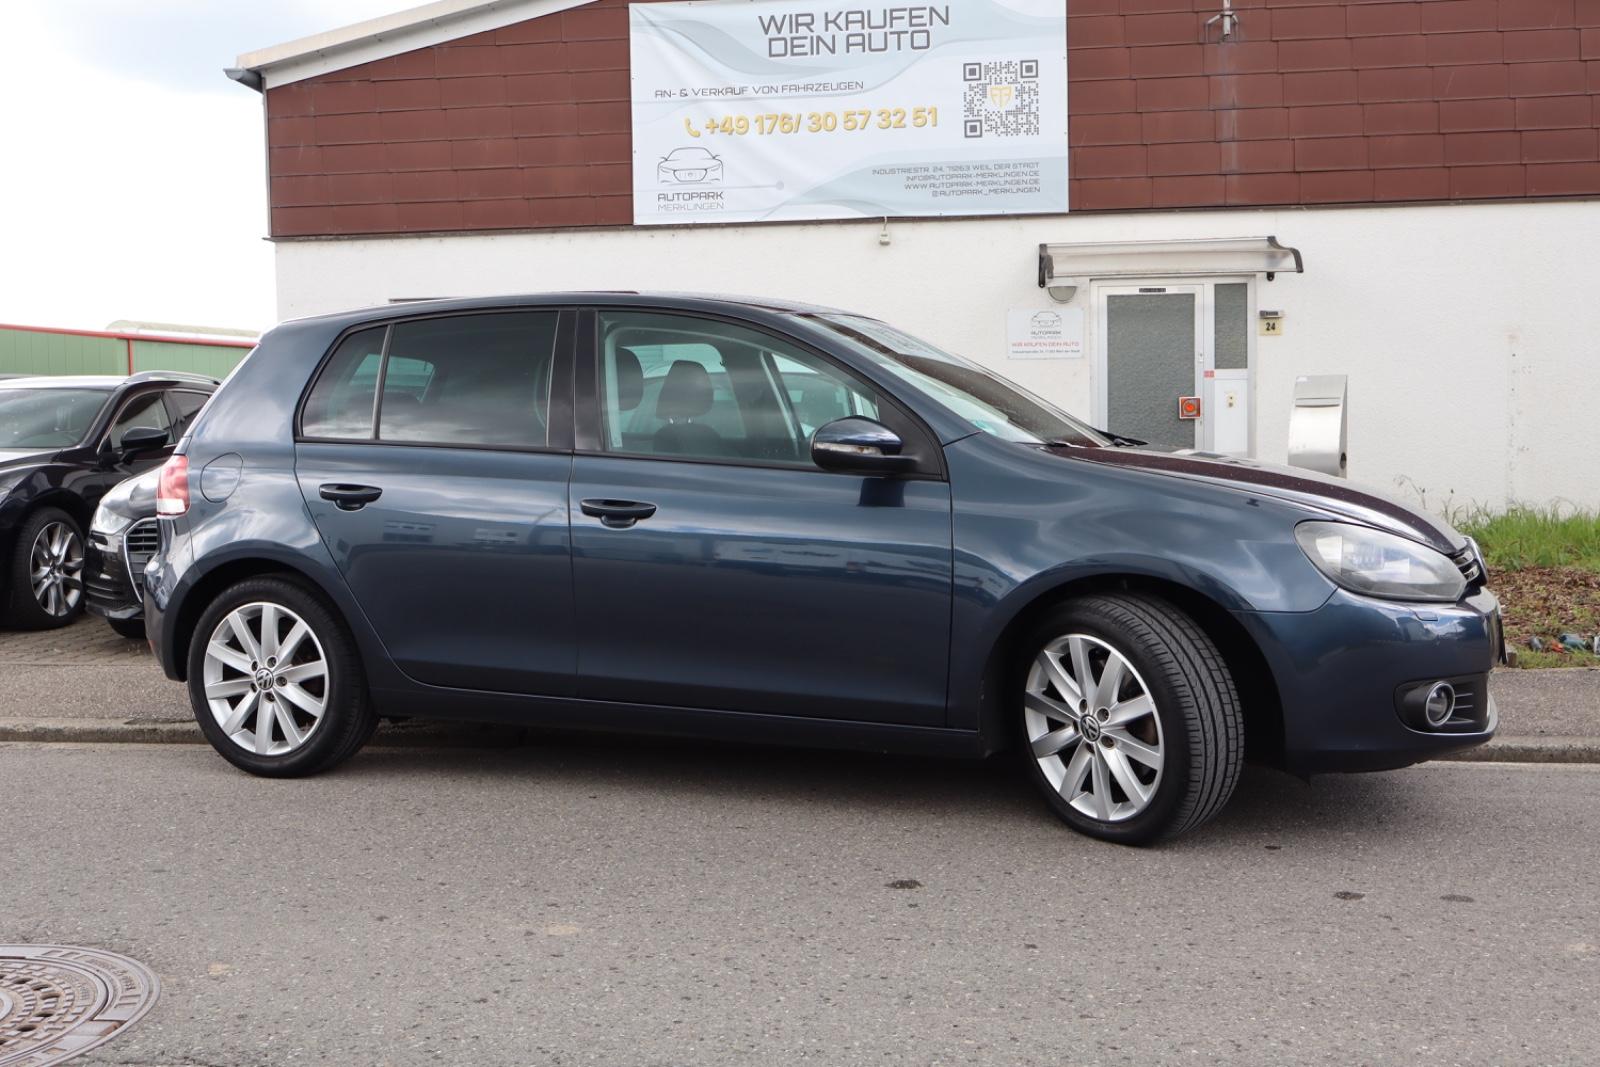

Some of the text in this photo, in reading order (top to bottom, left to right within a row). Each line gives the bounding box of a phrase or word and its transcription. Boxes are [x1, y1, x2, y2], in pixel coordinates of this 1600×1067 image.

[758, 5, 950, 35] WIR KAUFEN
[768, 29, 931, 58] DEIN AUTO
[680, 88, 689, 97] &
[692, 86, 749, 97] VERKAUF
[752, 85, 780, 95] VON
[781, 81, 864, 94] FAHRZEUGEN
[705, 105, 938, 136] +49 176/ 30 57 32 51
[657, 192, 724, 202] AUTOPARK
[657, 202, 724, 212] MERKLINGEN
[1265, 322, 1276, 332] 24
